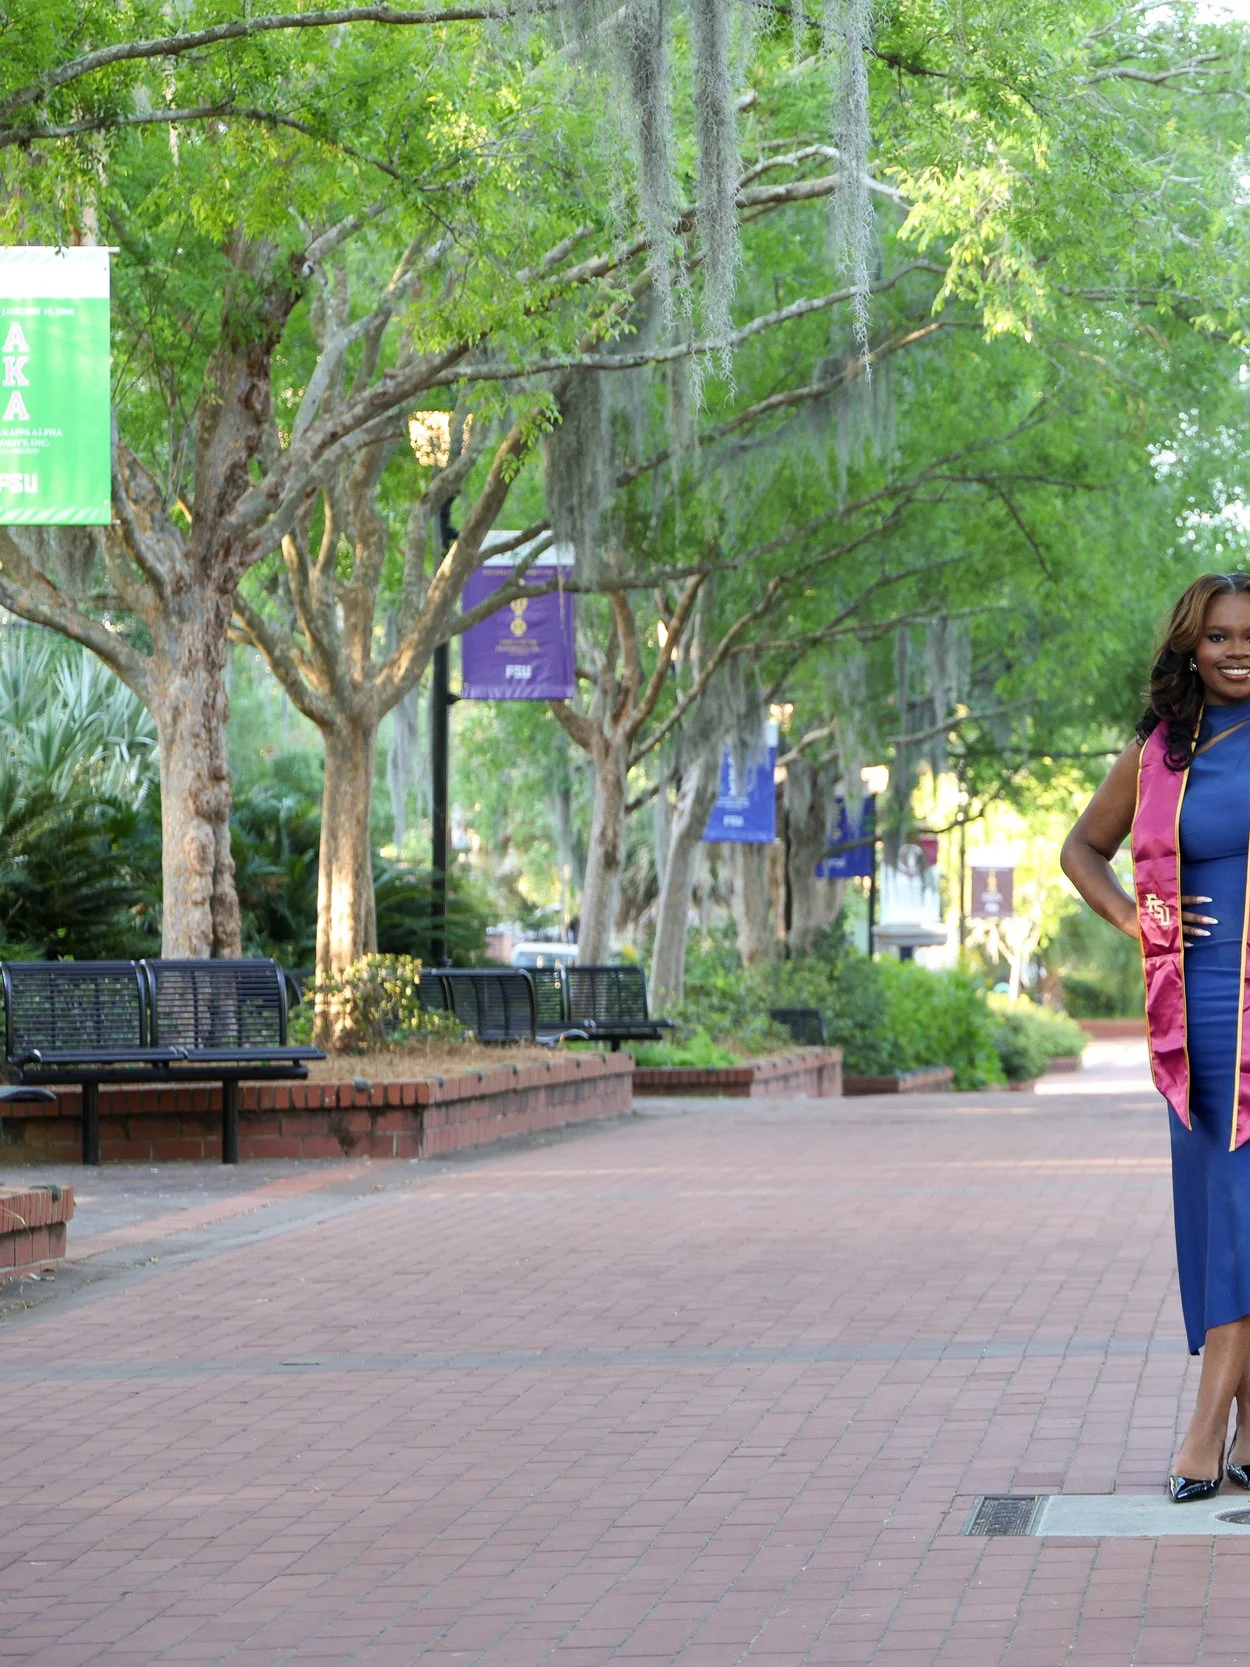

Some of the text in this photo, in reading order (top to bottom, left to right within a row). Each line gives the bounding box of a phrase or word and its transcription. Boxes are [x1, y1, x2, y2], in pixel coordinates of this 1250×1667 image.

[31, 427, 63, 437] ALPHA
[505, 664, 532, 680] FSU
[1145, 893, 1172, 926] FSU
